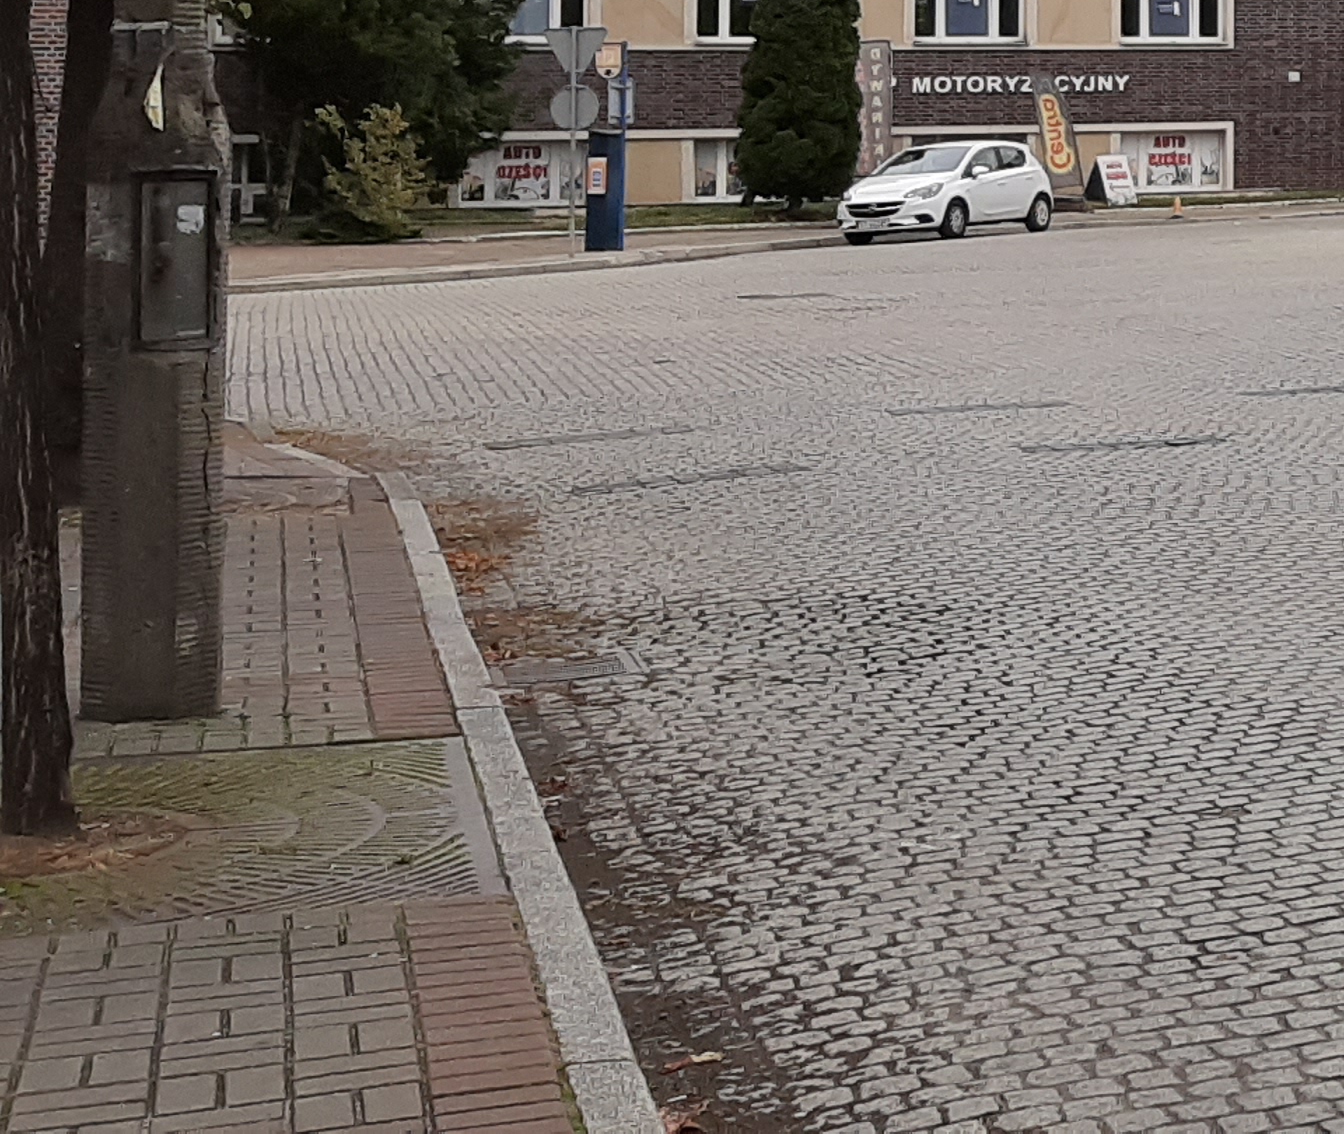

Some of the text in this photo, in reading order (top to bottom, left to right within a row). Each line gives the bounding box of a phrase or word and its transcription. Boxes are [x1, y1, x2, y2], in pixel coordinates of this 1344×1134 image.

[912, 75, 1130, 94] MOTORYZCYJNY
[1153, 135, 1186, 148] AUTO
[503, 146, 541, 160] AUTO
